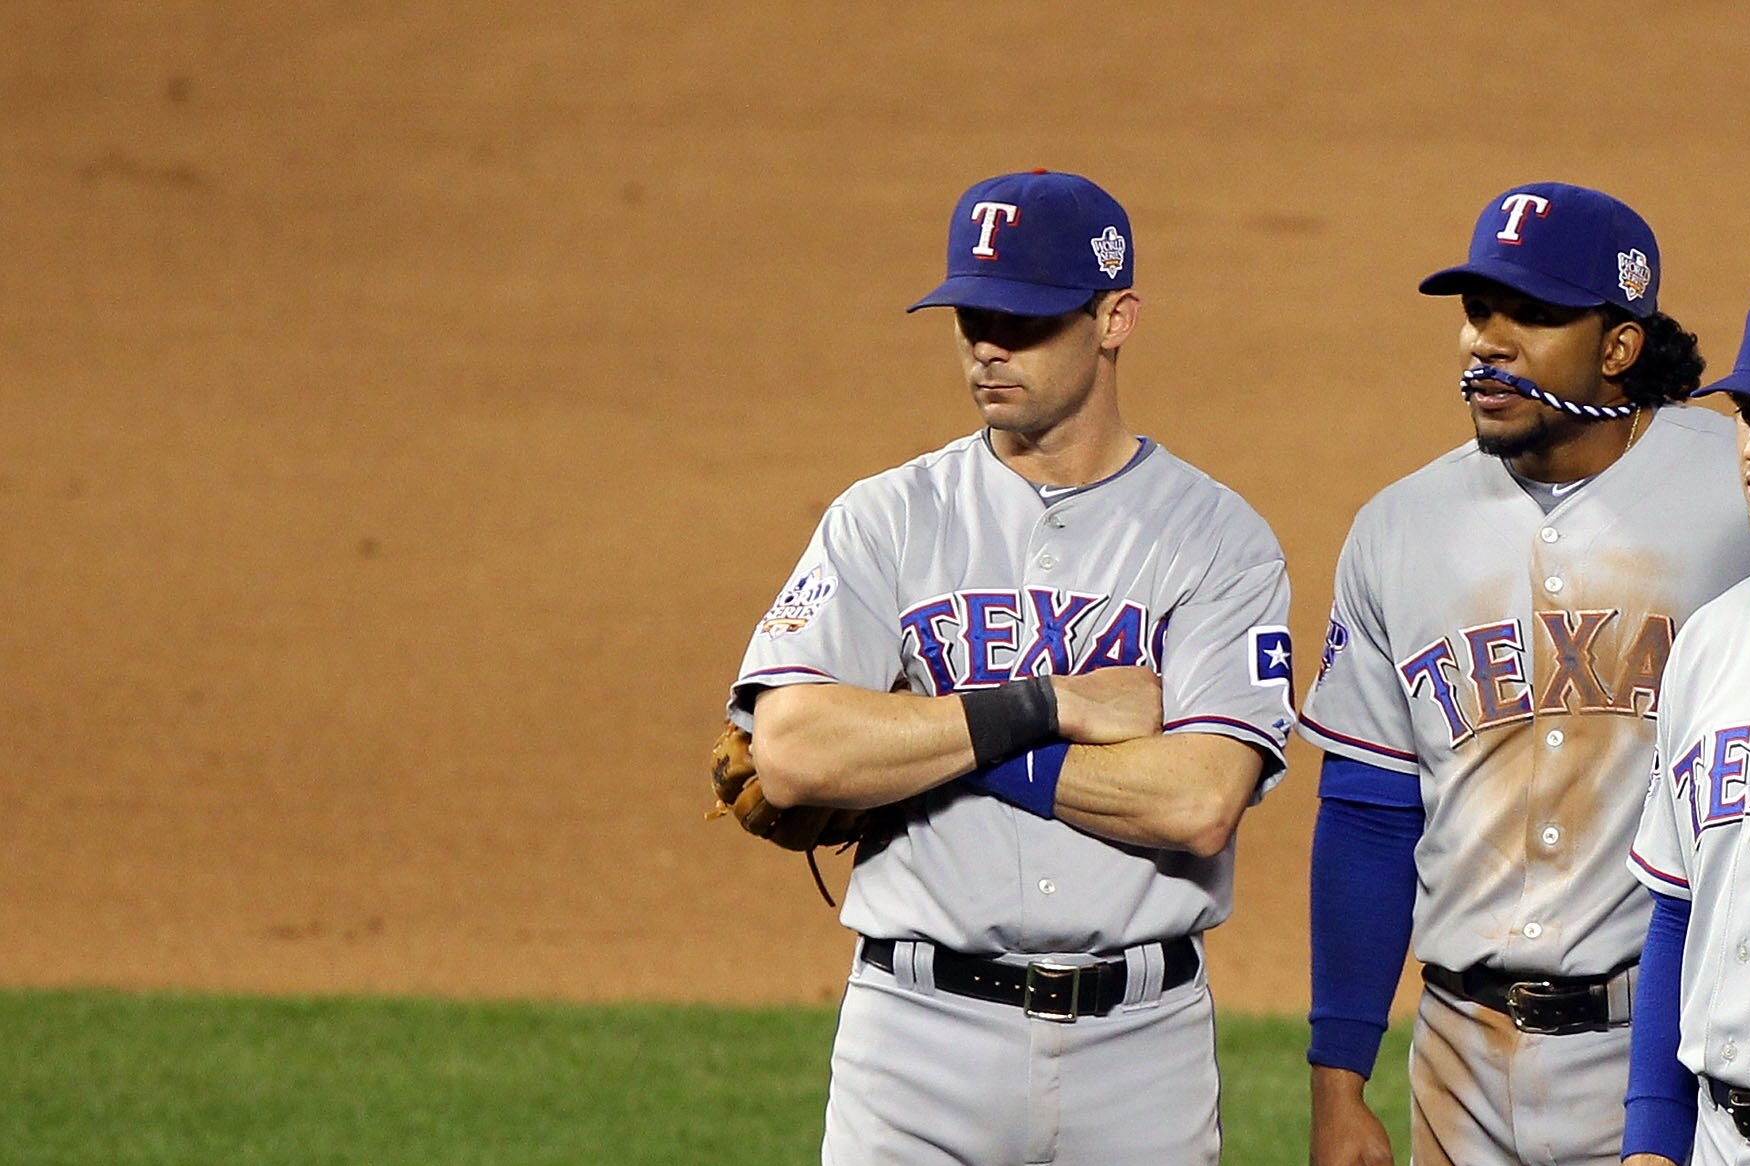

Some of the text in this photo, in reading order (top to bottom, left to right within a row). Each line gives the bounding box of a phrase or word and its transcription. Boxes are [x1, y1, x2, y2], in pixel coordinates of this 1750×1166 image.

[971, 202, 1020, 260] T
[1496, 193, 1551, 245] T
[899, 583, 1165, 698] TEXA
